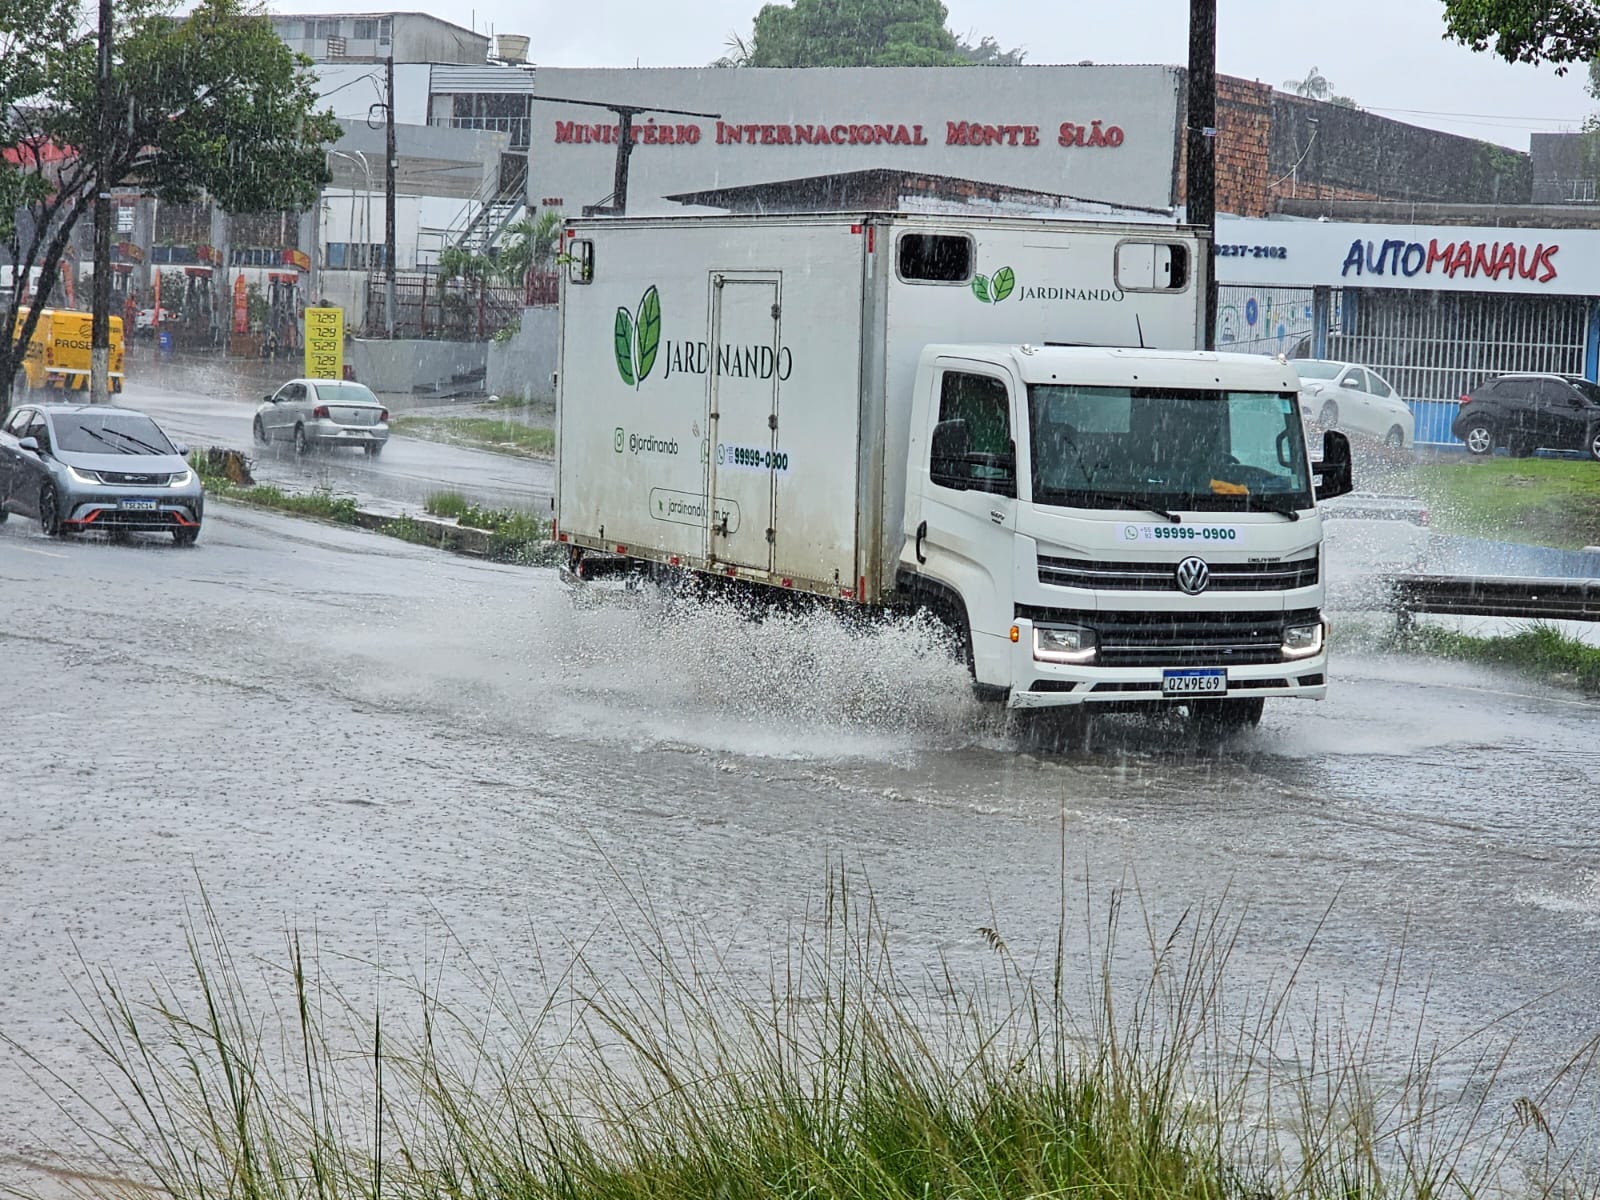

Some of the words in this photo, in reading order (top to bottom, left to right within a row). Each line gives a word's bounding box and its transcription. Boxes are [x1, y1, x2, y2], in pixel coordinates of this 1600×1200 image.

[716, 121, 927, 145] INTERNACIONAL
[946, 121, 1039, 146] MONTE
[1058, 119, 1125, 147] SIÃO
[1019, 286, 1125, 302] JARDINANDO
[54, 338, 117, 352] PROSER
[664, 340, 792, 381] JARDNANDO
[629, 433, 679, 456] @jardinando
[1154, 527, 1237, 540] 99999-0900
[1169, 677, 1219, 690] QZW9E69
